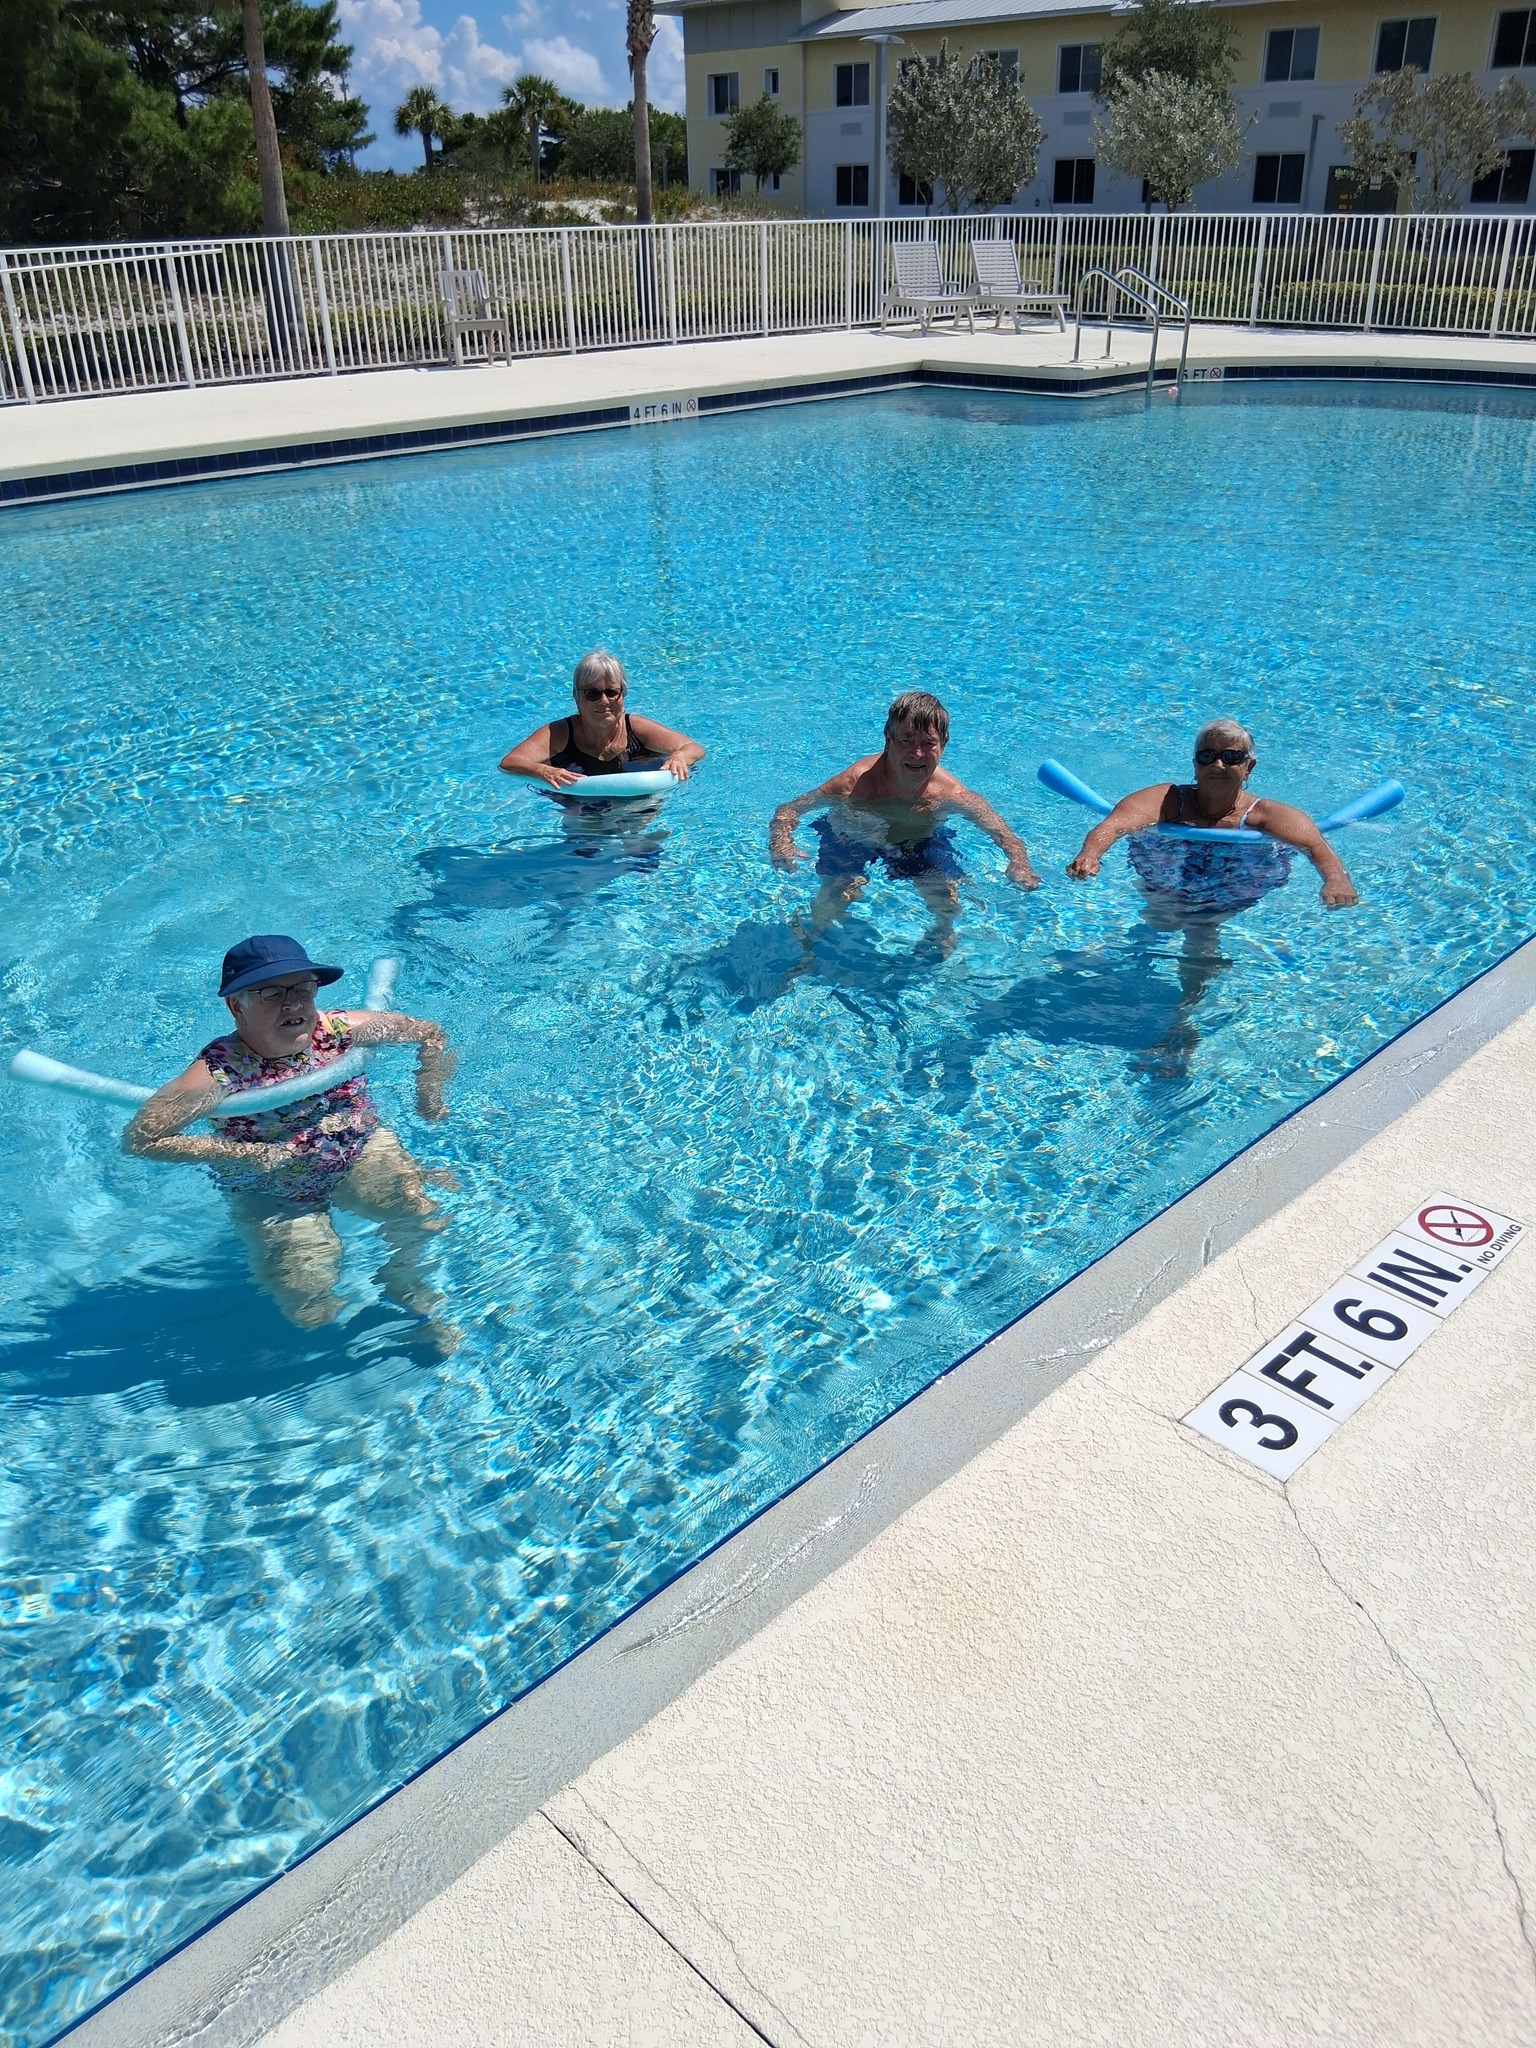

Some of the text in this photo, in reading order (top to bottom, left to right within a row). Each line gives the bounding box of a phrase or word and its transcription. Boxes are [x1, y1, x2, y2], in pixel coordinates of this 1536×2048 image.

[1193, 369, 1207, 380] FT
[633, 402, 681, 419] 4 FT 6 IN
[1476, 1224, 1523, 1265] NO DIVING
[1218, 1248, 1474, 1451] 3 FT. 6 IN.
